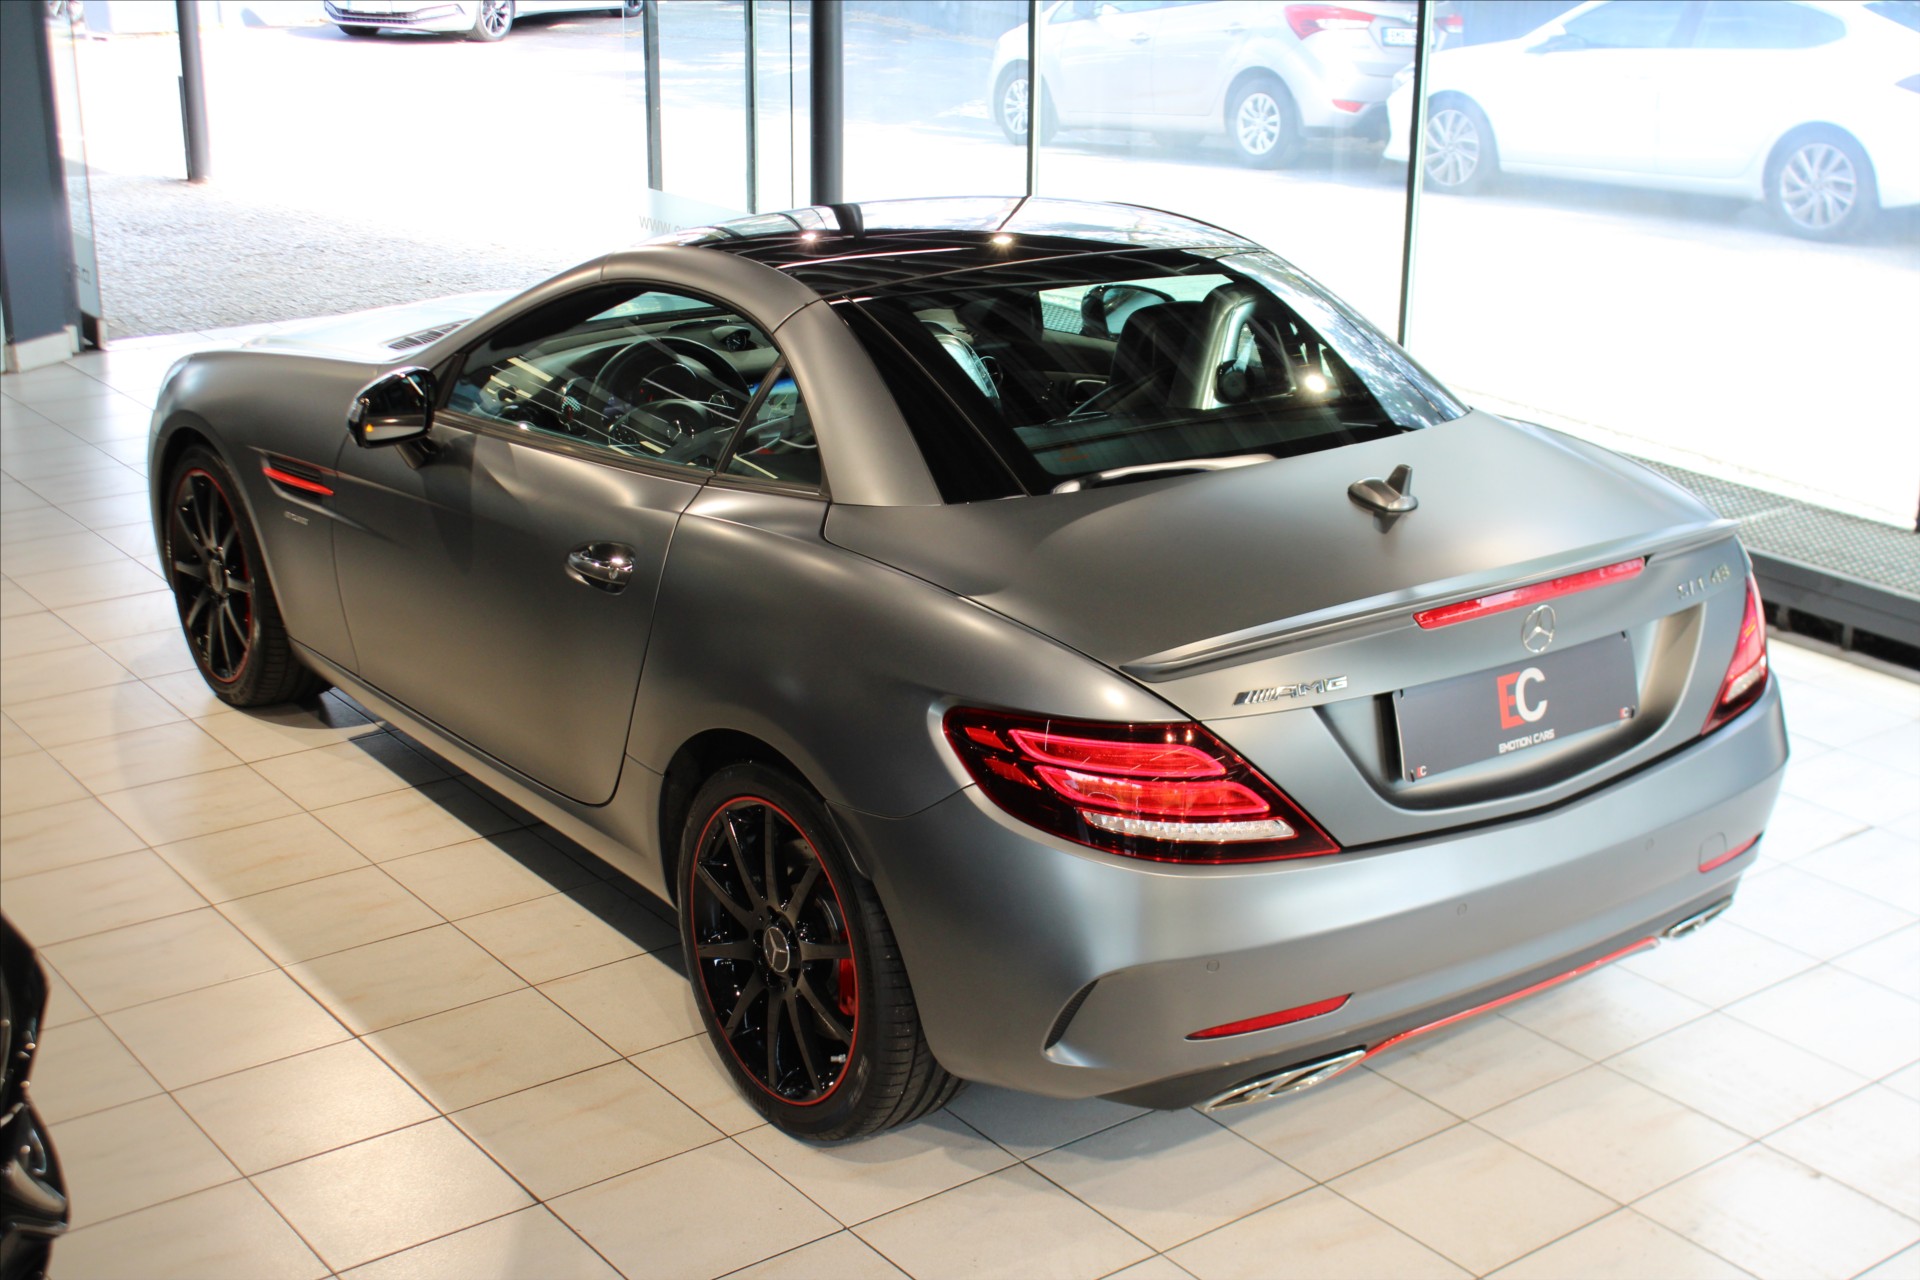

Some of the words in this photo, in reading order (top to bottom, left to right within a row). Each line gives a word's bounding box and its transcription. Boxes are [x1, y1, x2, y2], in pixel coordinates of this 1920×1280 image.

[1272, 676, 1348, 700] AMG
[1498, 735, 1533, 754] EMOTION
[1532, 728, 1556, 744] CARS
